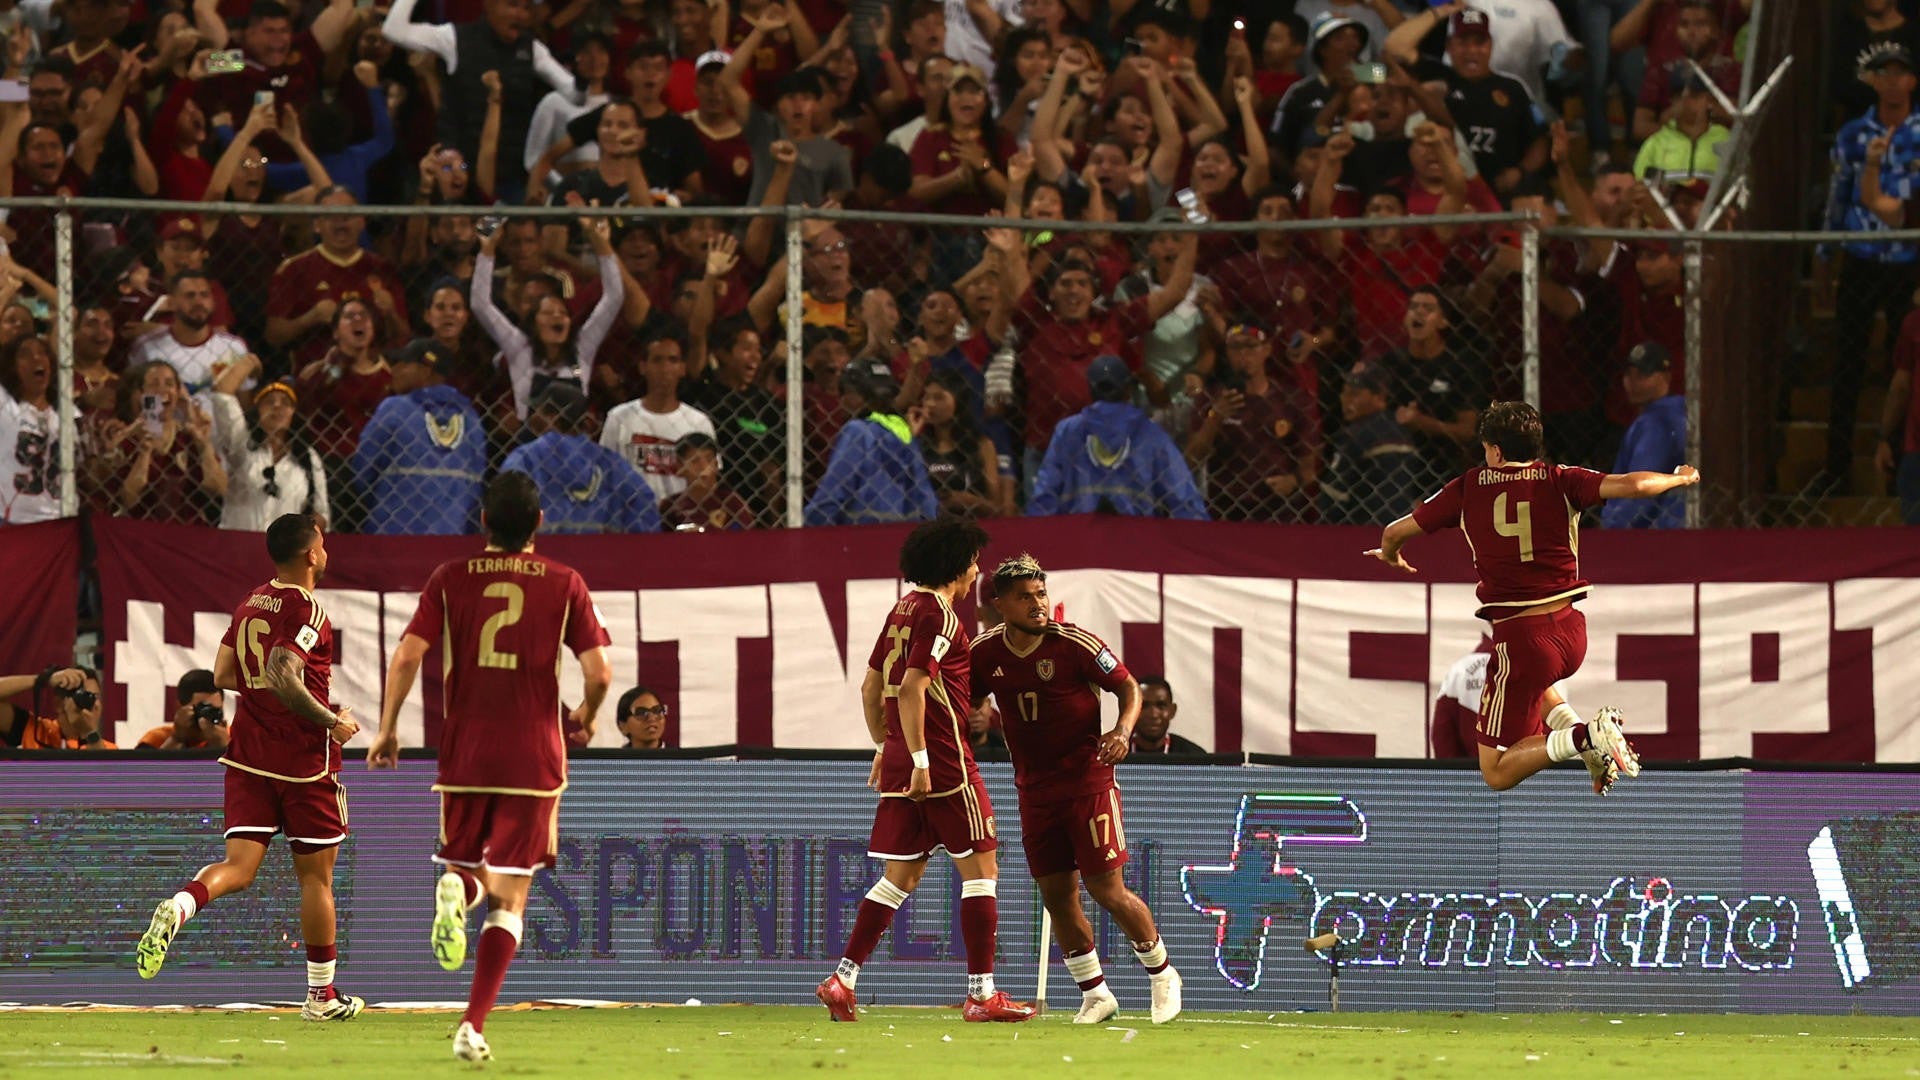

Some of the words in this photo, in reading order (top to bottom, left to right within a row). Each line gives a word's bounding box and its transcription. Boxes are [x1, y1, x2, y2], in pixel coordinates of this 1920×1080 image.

[1493, 491, 1535, 563] 4
[467, 557, 547, 577] FERRARESI
[477, 581, 525, 670] 2
[1016, 691, 1039, 722] 17
[1088, 813, 1110, 849] 17
